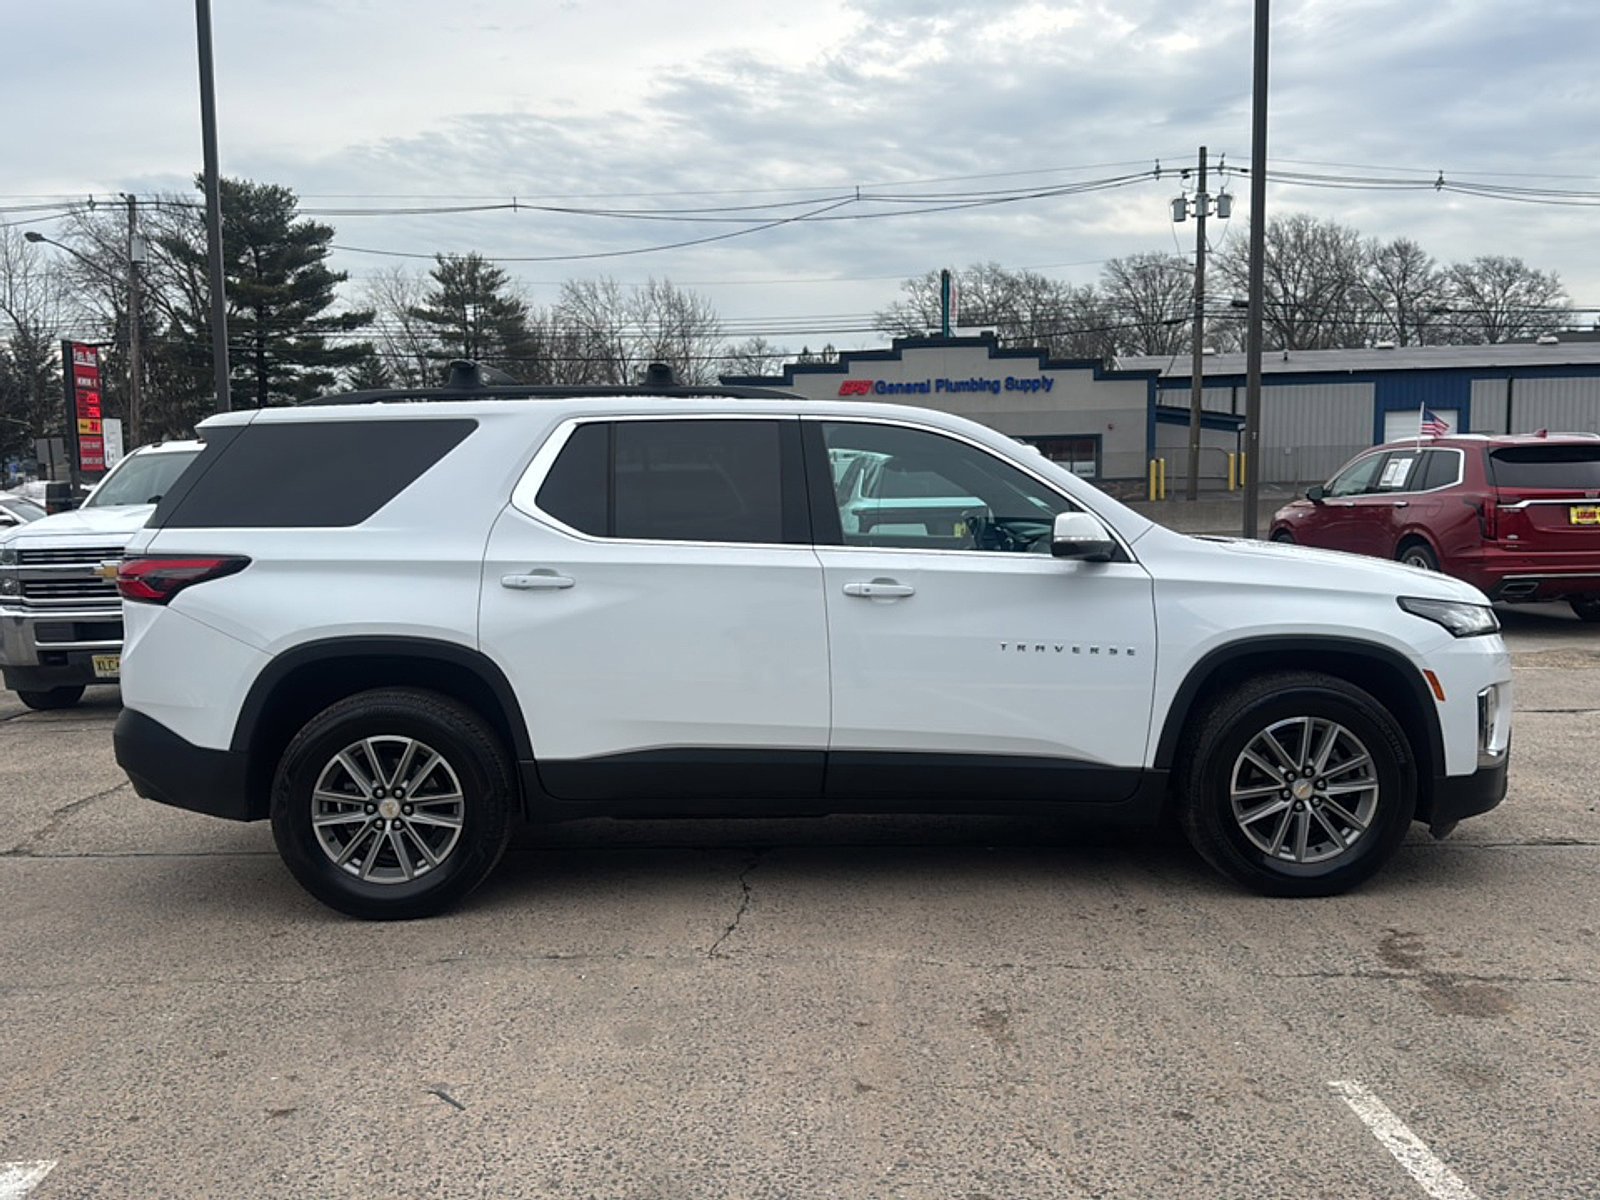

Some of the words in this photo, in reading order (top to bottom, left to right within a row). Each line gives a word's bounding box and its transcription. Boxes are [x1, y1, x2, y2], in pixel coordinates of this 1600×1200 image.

[875, 379, 930, 395] General
[935, 377, 1000, 395] Plumbing
[1004, 375, 1054, 394] Supply
[1000, 642, 1136, 656] TRAVERSE
